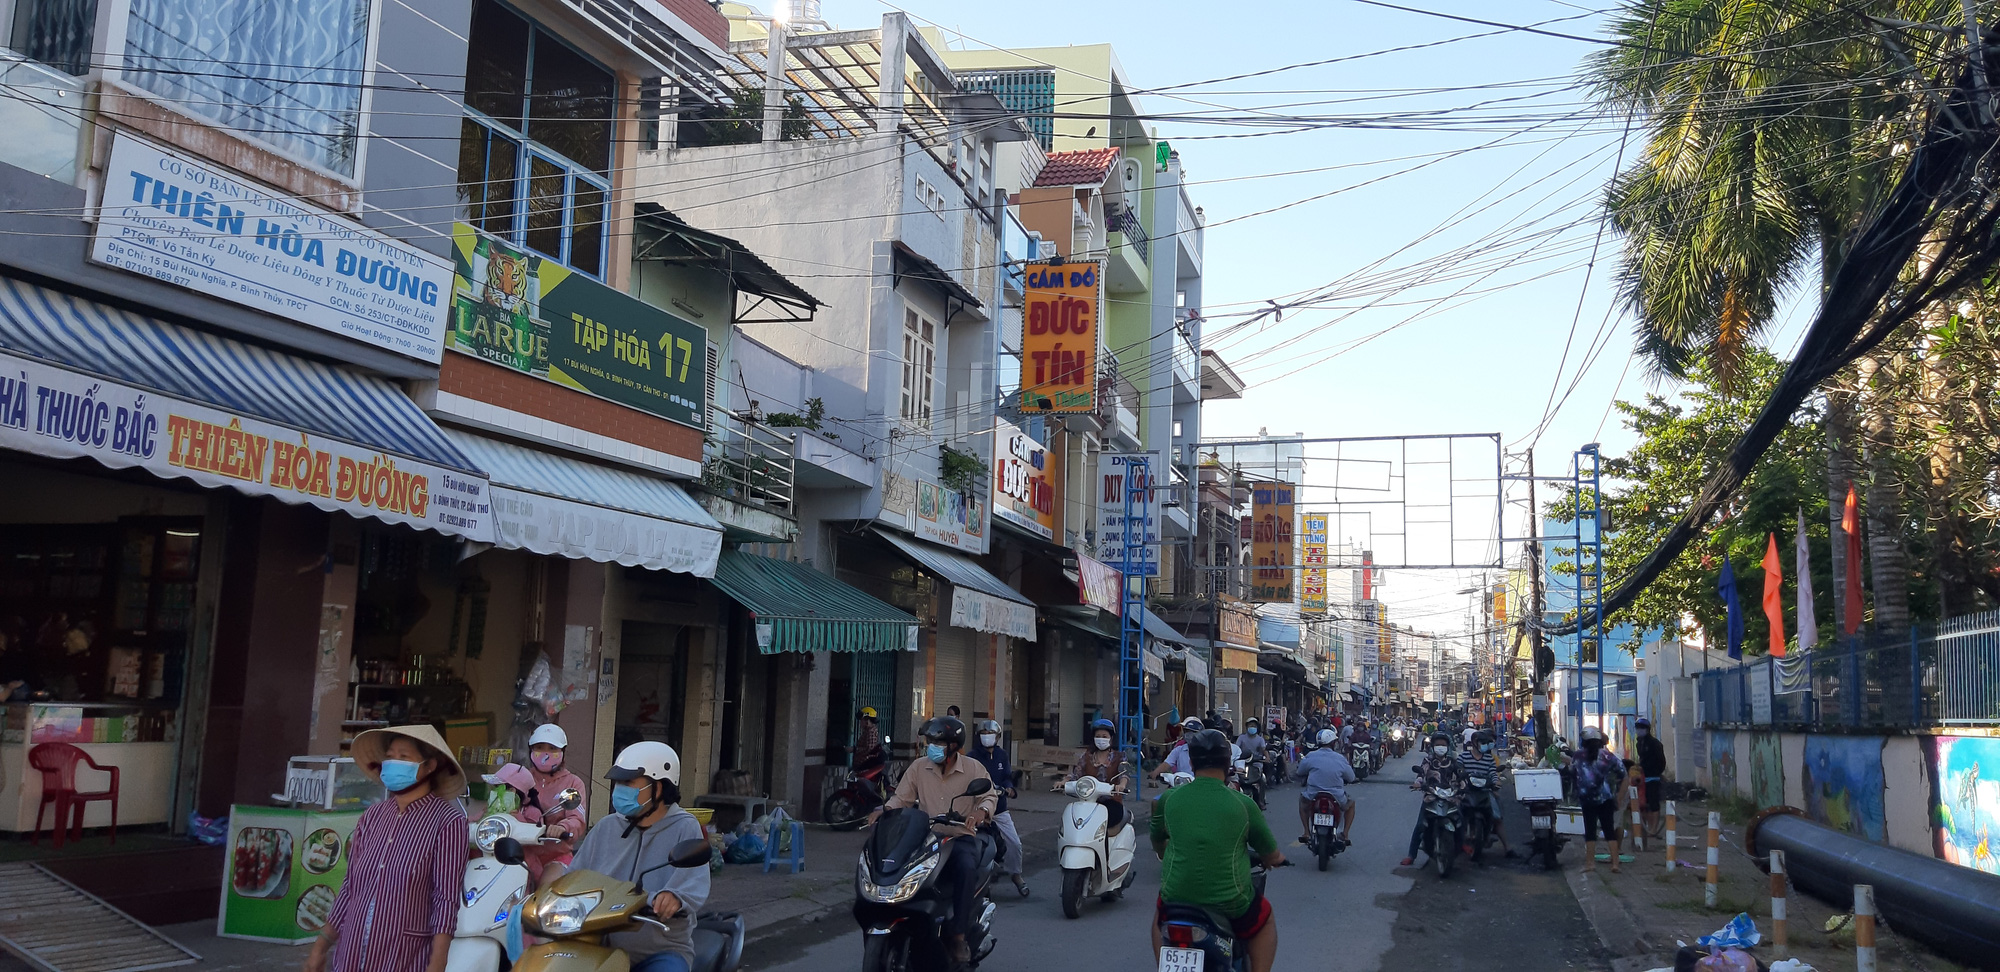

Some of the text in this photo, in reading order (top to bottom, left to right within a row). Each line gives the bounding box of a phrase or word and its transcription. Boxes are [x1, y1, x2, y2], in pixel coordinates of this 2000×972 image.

[160, 157, 181, 175] CƠ
[184, 167, 206, 184] SỞ
[318, 220, 326, 231] Y
[329, 224, 356, 242] HỌC
[377, 242, 425, 270] TRUYỀN
[130, 170, 438, 307] THIÊN HÒA ĐƯỜNG
[105, 255, 190, 287] ĐT: 07103 889 677
[122, 207, 175, 235] Chuyên
[209, 237, 225, 252] Lẻ
[228, 243, 259, 264] Dược
[262, 255, 289, 274] Liệu
[292, 266, 323, 287] Đông
[326, 276, 335, 288] Y
[336, 279, 369, 300] Thuốc
[371, 291, 386, 306] Từ
[387, 297, 413, 316] Dược
[415, 308, 436, 324] Liệu
[122, 227, 159, 247] PTCM:
[162, 239, 177, 253] Võ
[180, 244, 199, 261] Tấn
[202, 255, 216, 268] Kỳ
[329, 296, 352, 311] GCN:
[354, 303, 367, 315] Số
[108, 242, 125, 256] Địa
[127, 246, 146, 262] Chỉ:
[149, 255, 161, 265] 15
[163, 258, 179, 272] Bùi
[180, 263, 199, 278] Hữu
[230, 280, 238, 291] P.
[240, 283, 261, 298] Bình
[286, 298, 309, 312] TPCT
[341, 319, 355, 332] Giờ
[356, 323, 372, 337] Hoạt
[373, 330, 394, 345] Động:
[395, 337, 411, 349] 7h00
[416, 343, 436, 356] 20h00
[1029, 292, 1090, 336] ĐỨC
[499, 312, 513, 325] BIA
[457, 306, 692, 384] LARUE TẠP HÓA 17
[482, 346, 525, 370] SPECIAL
[563, 356, 570, 366] 17
[1031, 342, 1086, 386] TÍN
[0, 370, 430, 520] HÀ THUỐC BẮC THIÊN HÒA ĐƯỜNG
[1112, 456, 1150, 466] DNN
[442, 474, 451, 489] 15
[998, 458, 1030, 503] ĐỨC
[1029, 475, 1054, 517] TÍN
[1104, 474, 1123, 504] DUY
[467, 518, 478, 530] 677
[477, 503, 490, 515] THƠ
[1305, 518, 1325, 533] TIỆM
[1166, 949, 1198, 966] 65-F1
